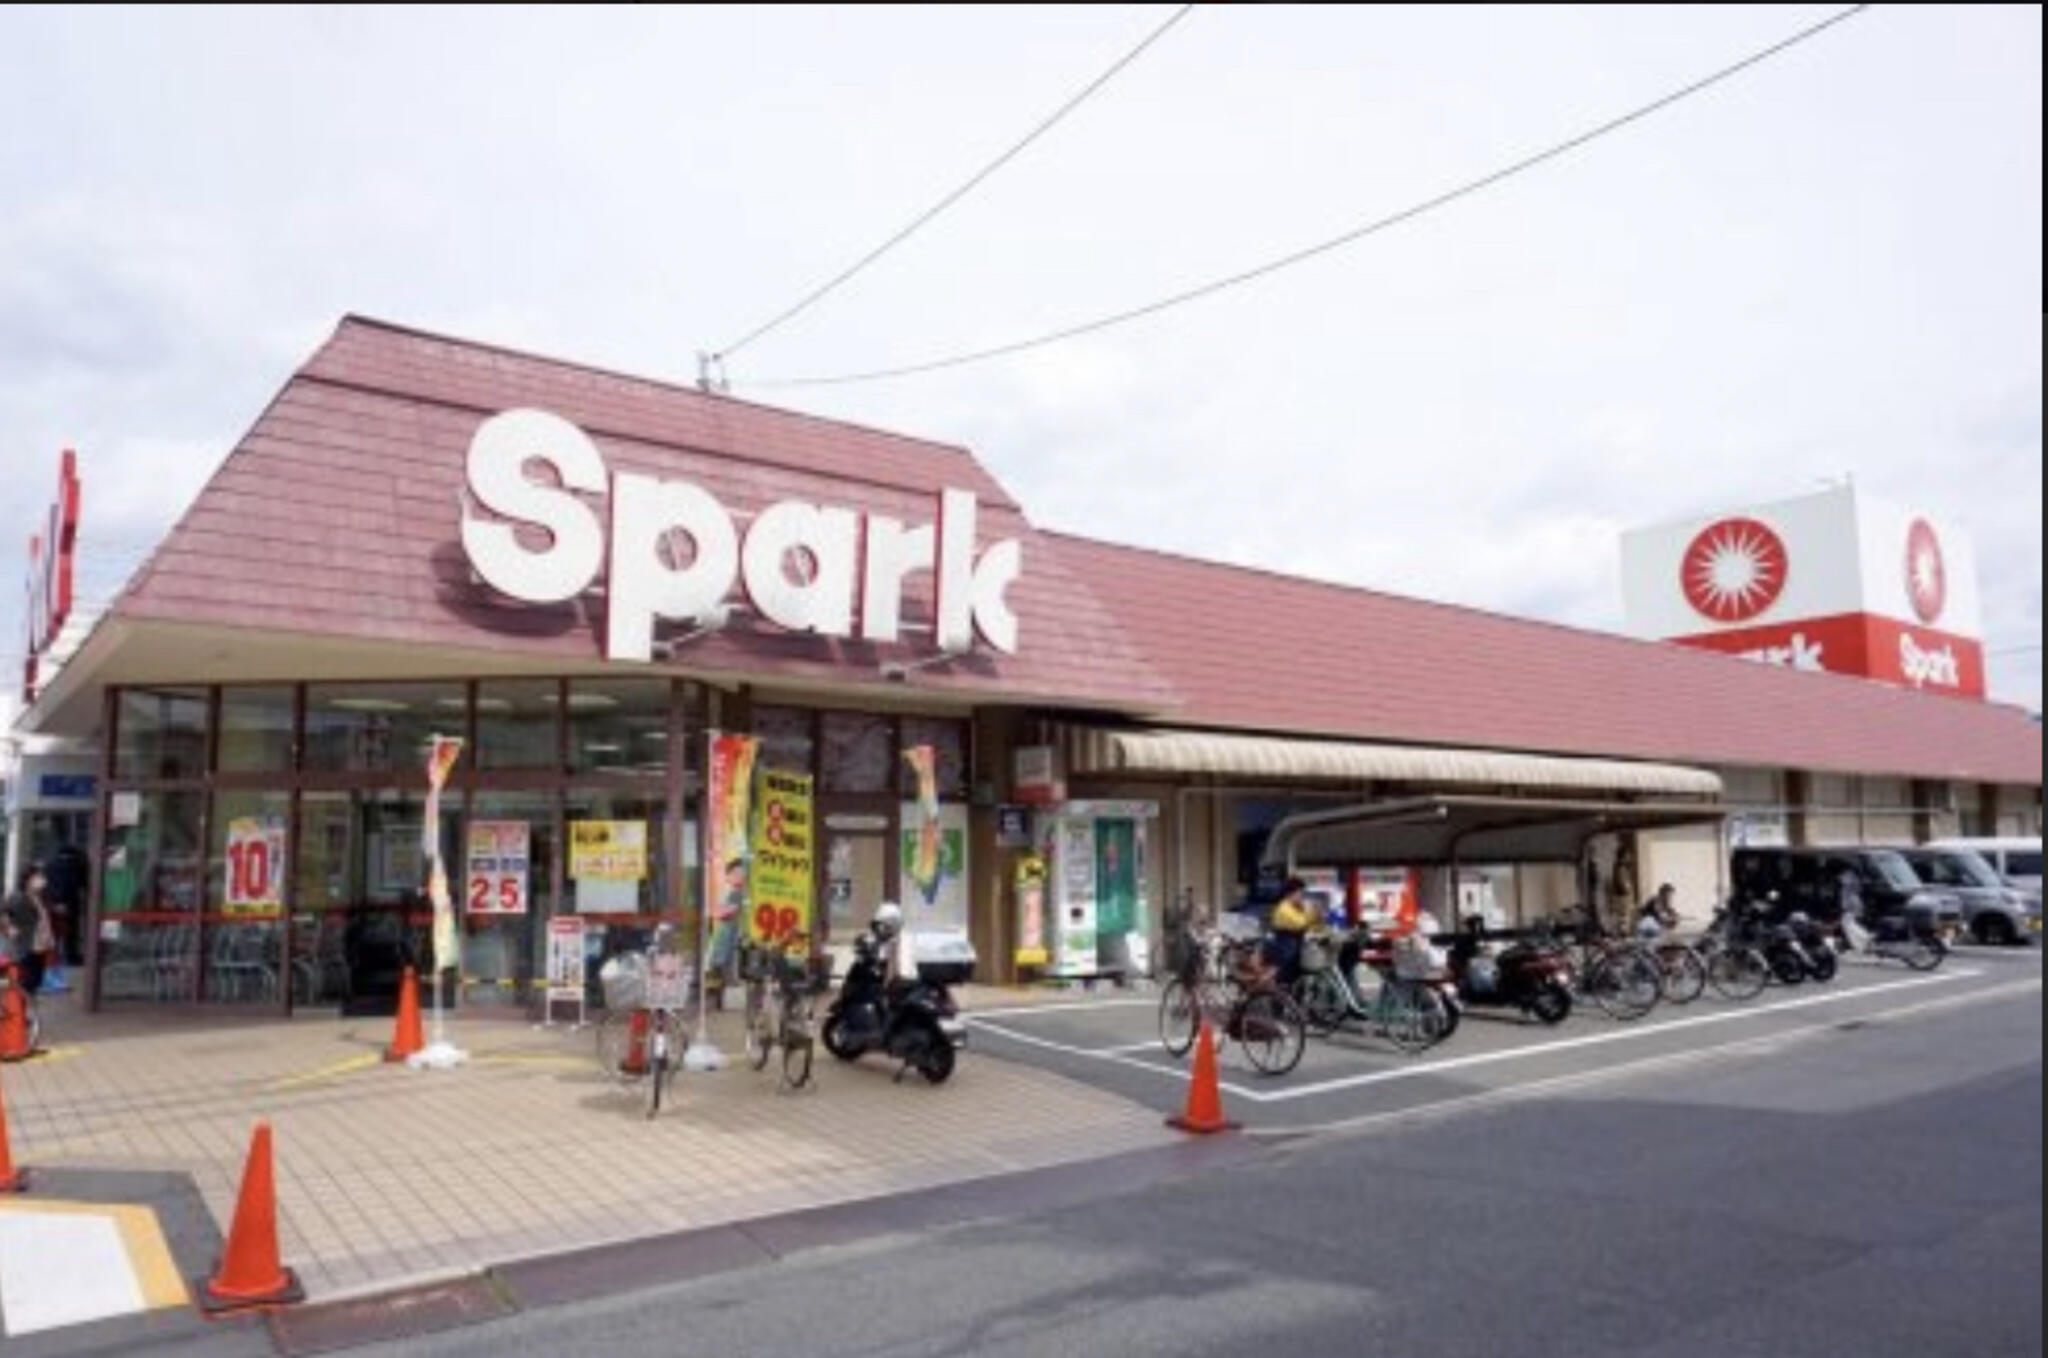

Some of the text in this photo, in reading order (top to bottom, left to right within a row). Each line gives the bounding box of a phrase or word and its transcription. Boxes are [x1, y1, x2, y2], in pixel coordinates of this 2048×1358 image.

[462, 407, 1021, 662] Spark
[1899, 631, 1960, 688] Spark
[228, 840, 268, 900] 10
